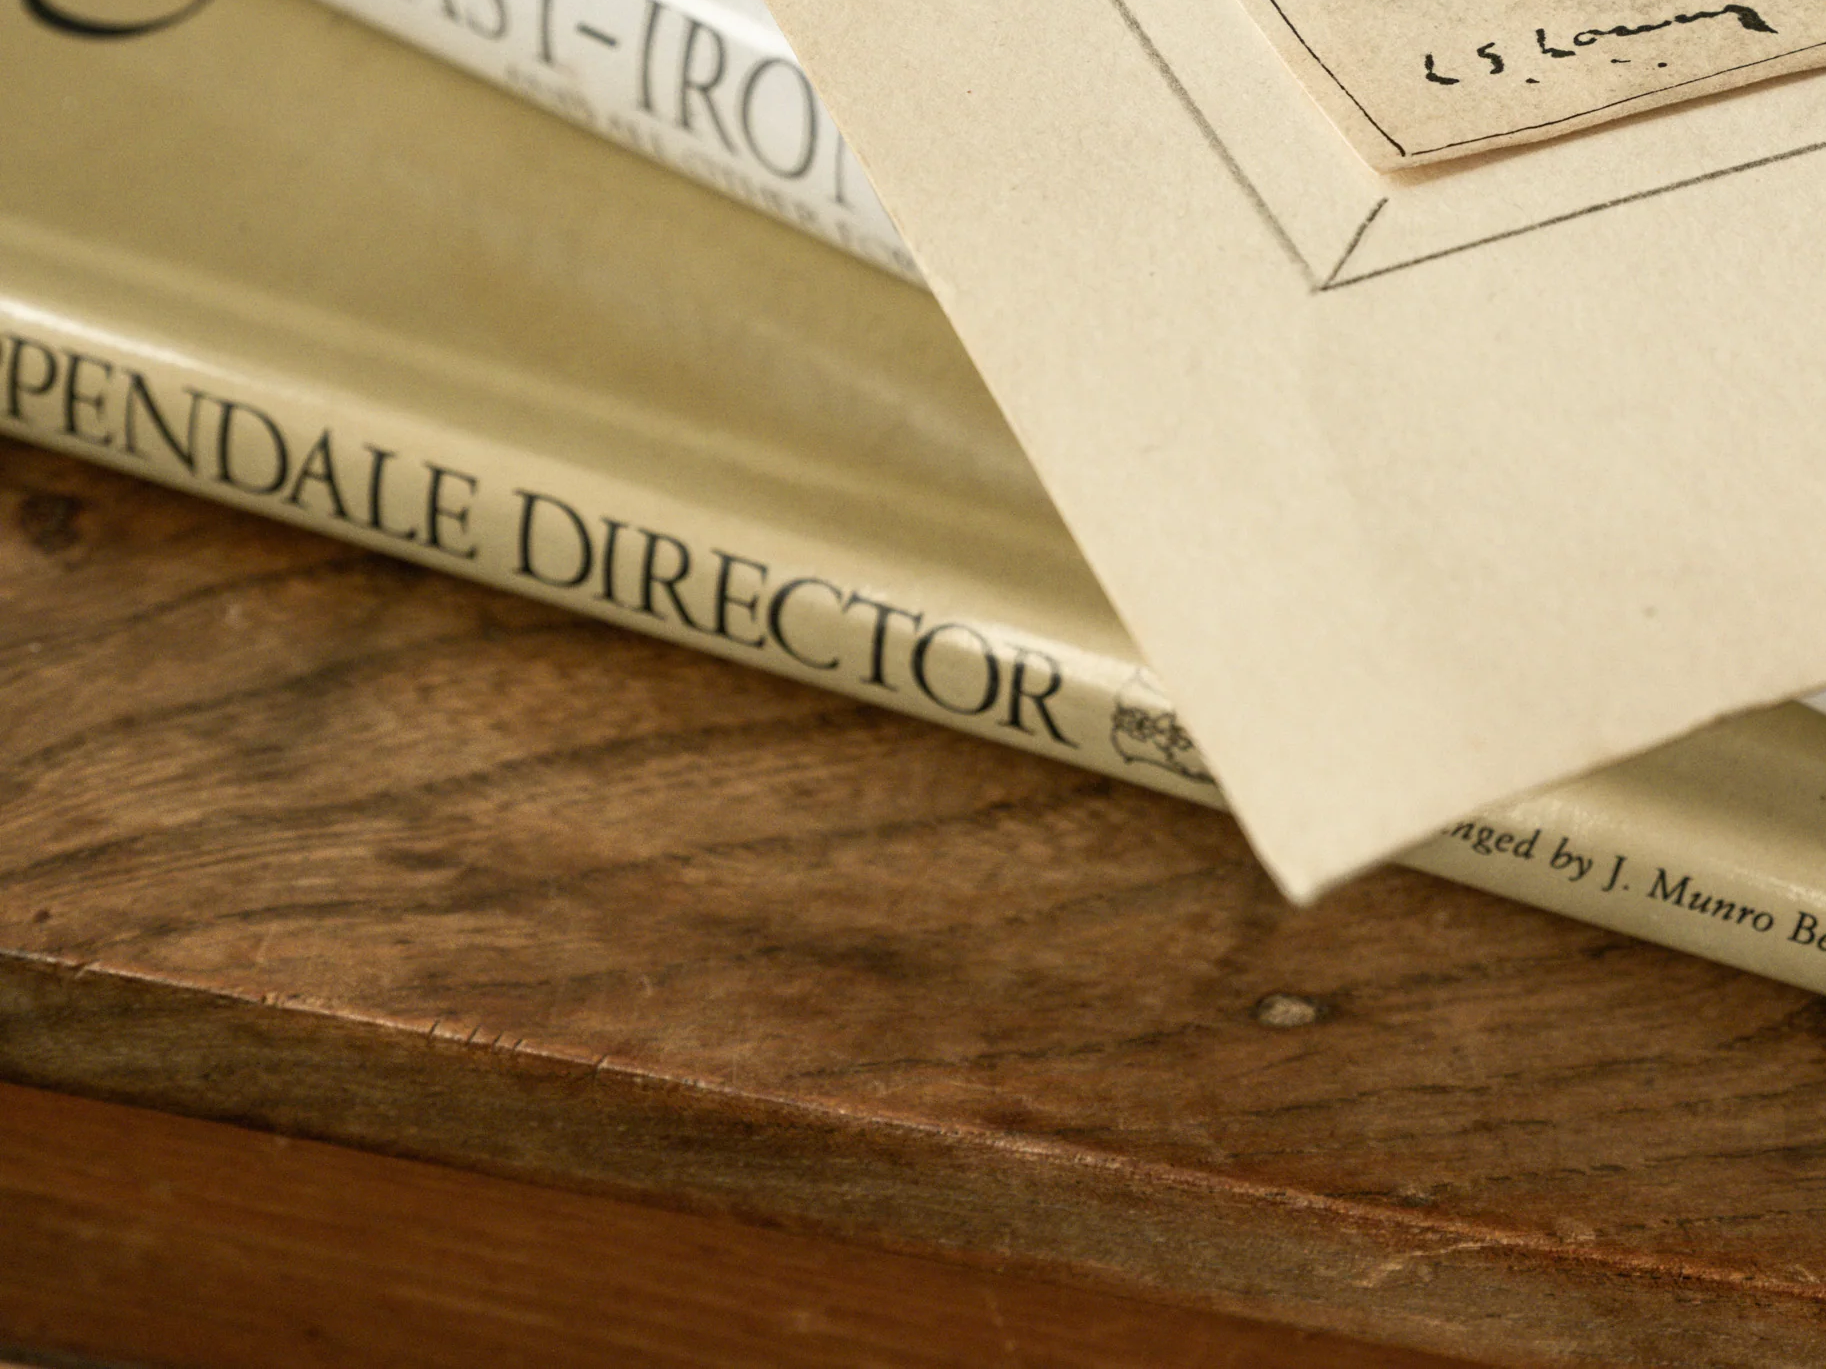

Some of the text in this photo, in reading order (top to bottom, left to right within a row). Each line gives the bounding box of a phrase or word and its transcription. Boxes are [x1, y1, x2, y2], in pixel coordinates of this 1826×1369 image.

[0, 333, 1081, 751] PENDALE DIRECTOR
[1441, 821, 1543, 861] nged
[1549, 836, 1594, 881] by
[1602, 854, 1630, 893] J.
[1647, 867, 1776, 934] Munro
